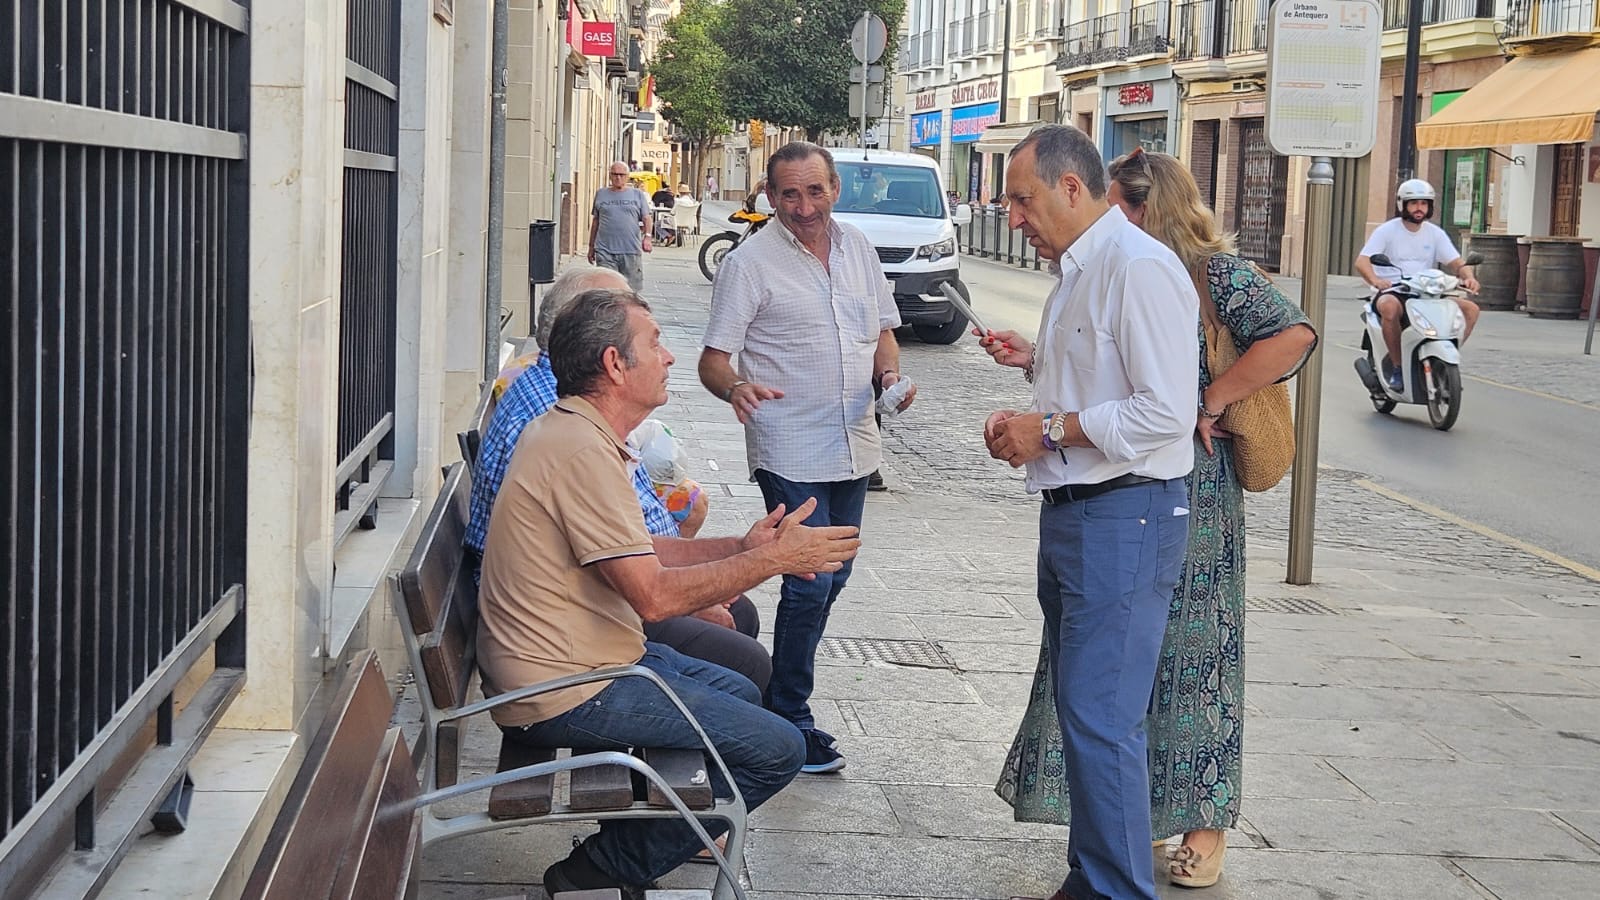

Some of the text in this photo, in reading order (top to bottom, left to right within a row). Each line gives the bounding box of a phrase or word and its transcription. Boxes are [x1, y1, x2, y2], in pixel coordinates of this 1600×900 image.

[1293, 3, 1318, 11] Urbano
[1293, 11, 1329, 20] Antequera
[583, 31, 613, 42] GAES
[951, 81, 999, 105] SANTA CRUZ
[915, 93, 936, 111] BAZAR
